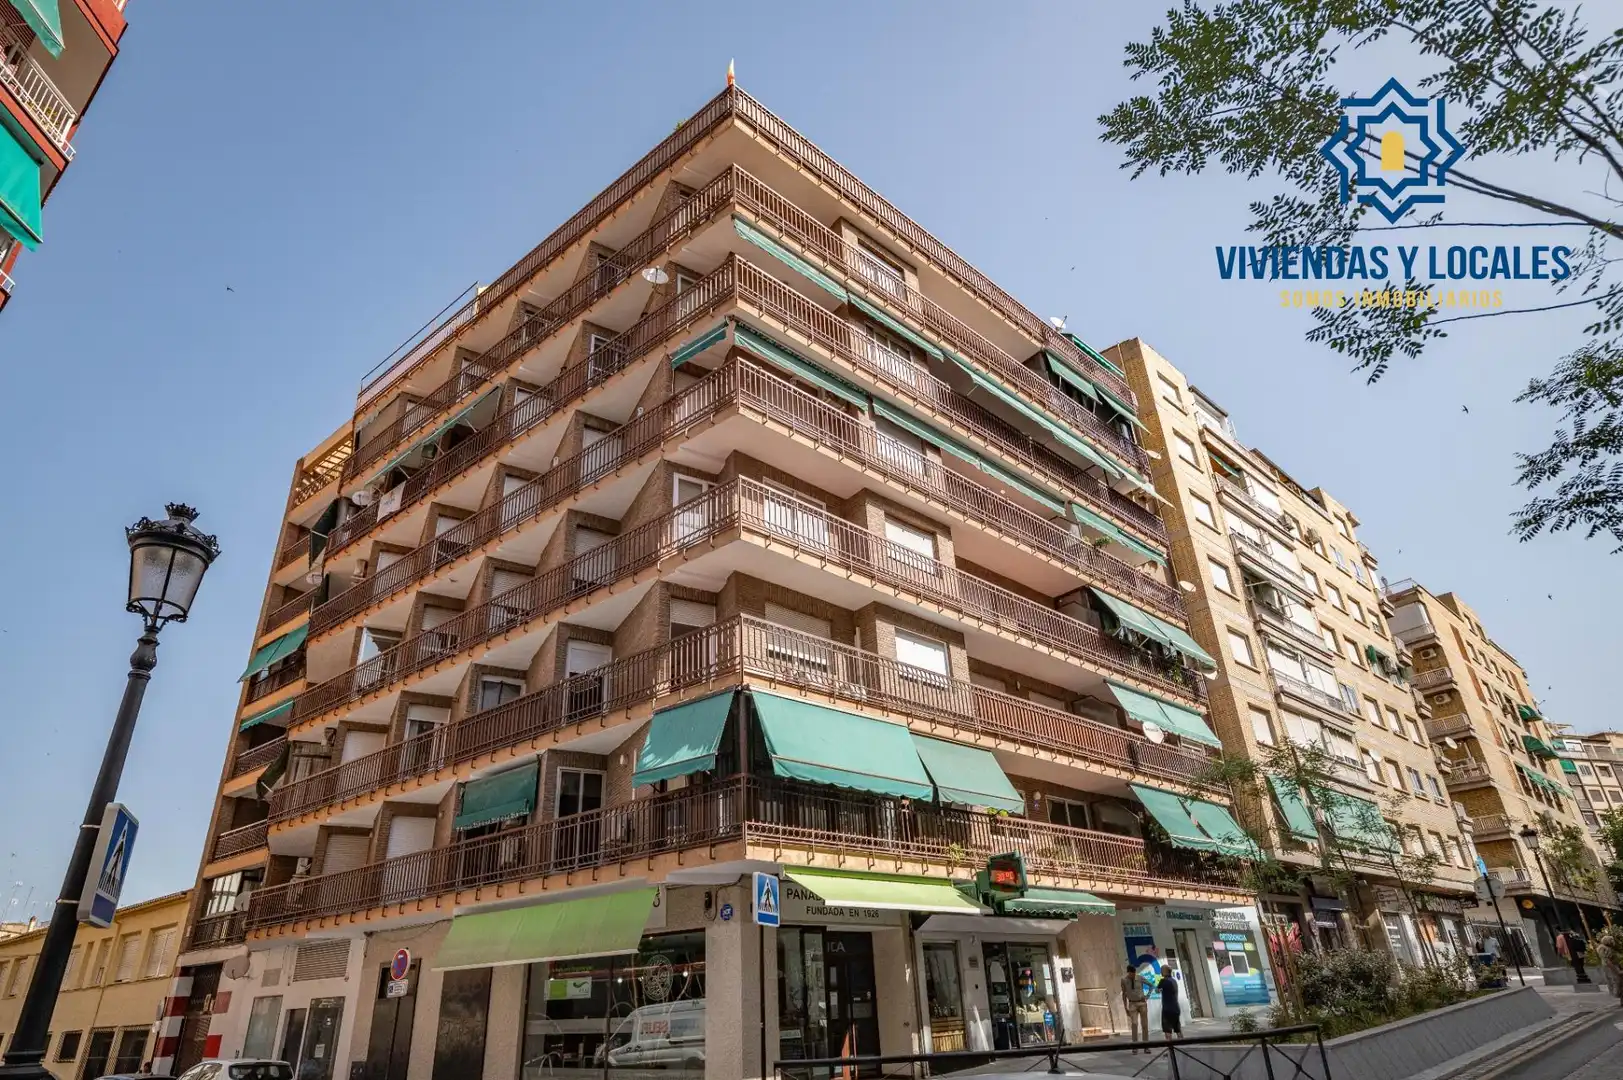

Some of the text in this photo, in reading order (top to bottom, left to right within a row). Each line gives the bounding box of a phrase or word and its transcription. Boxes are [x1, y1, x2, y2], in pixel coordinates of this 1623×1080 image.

[806, 905, 880, 919] FUNDADA EN 1926
